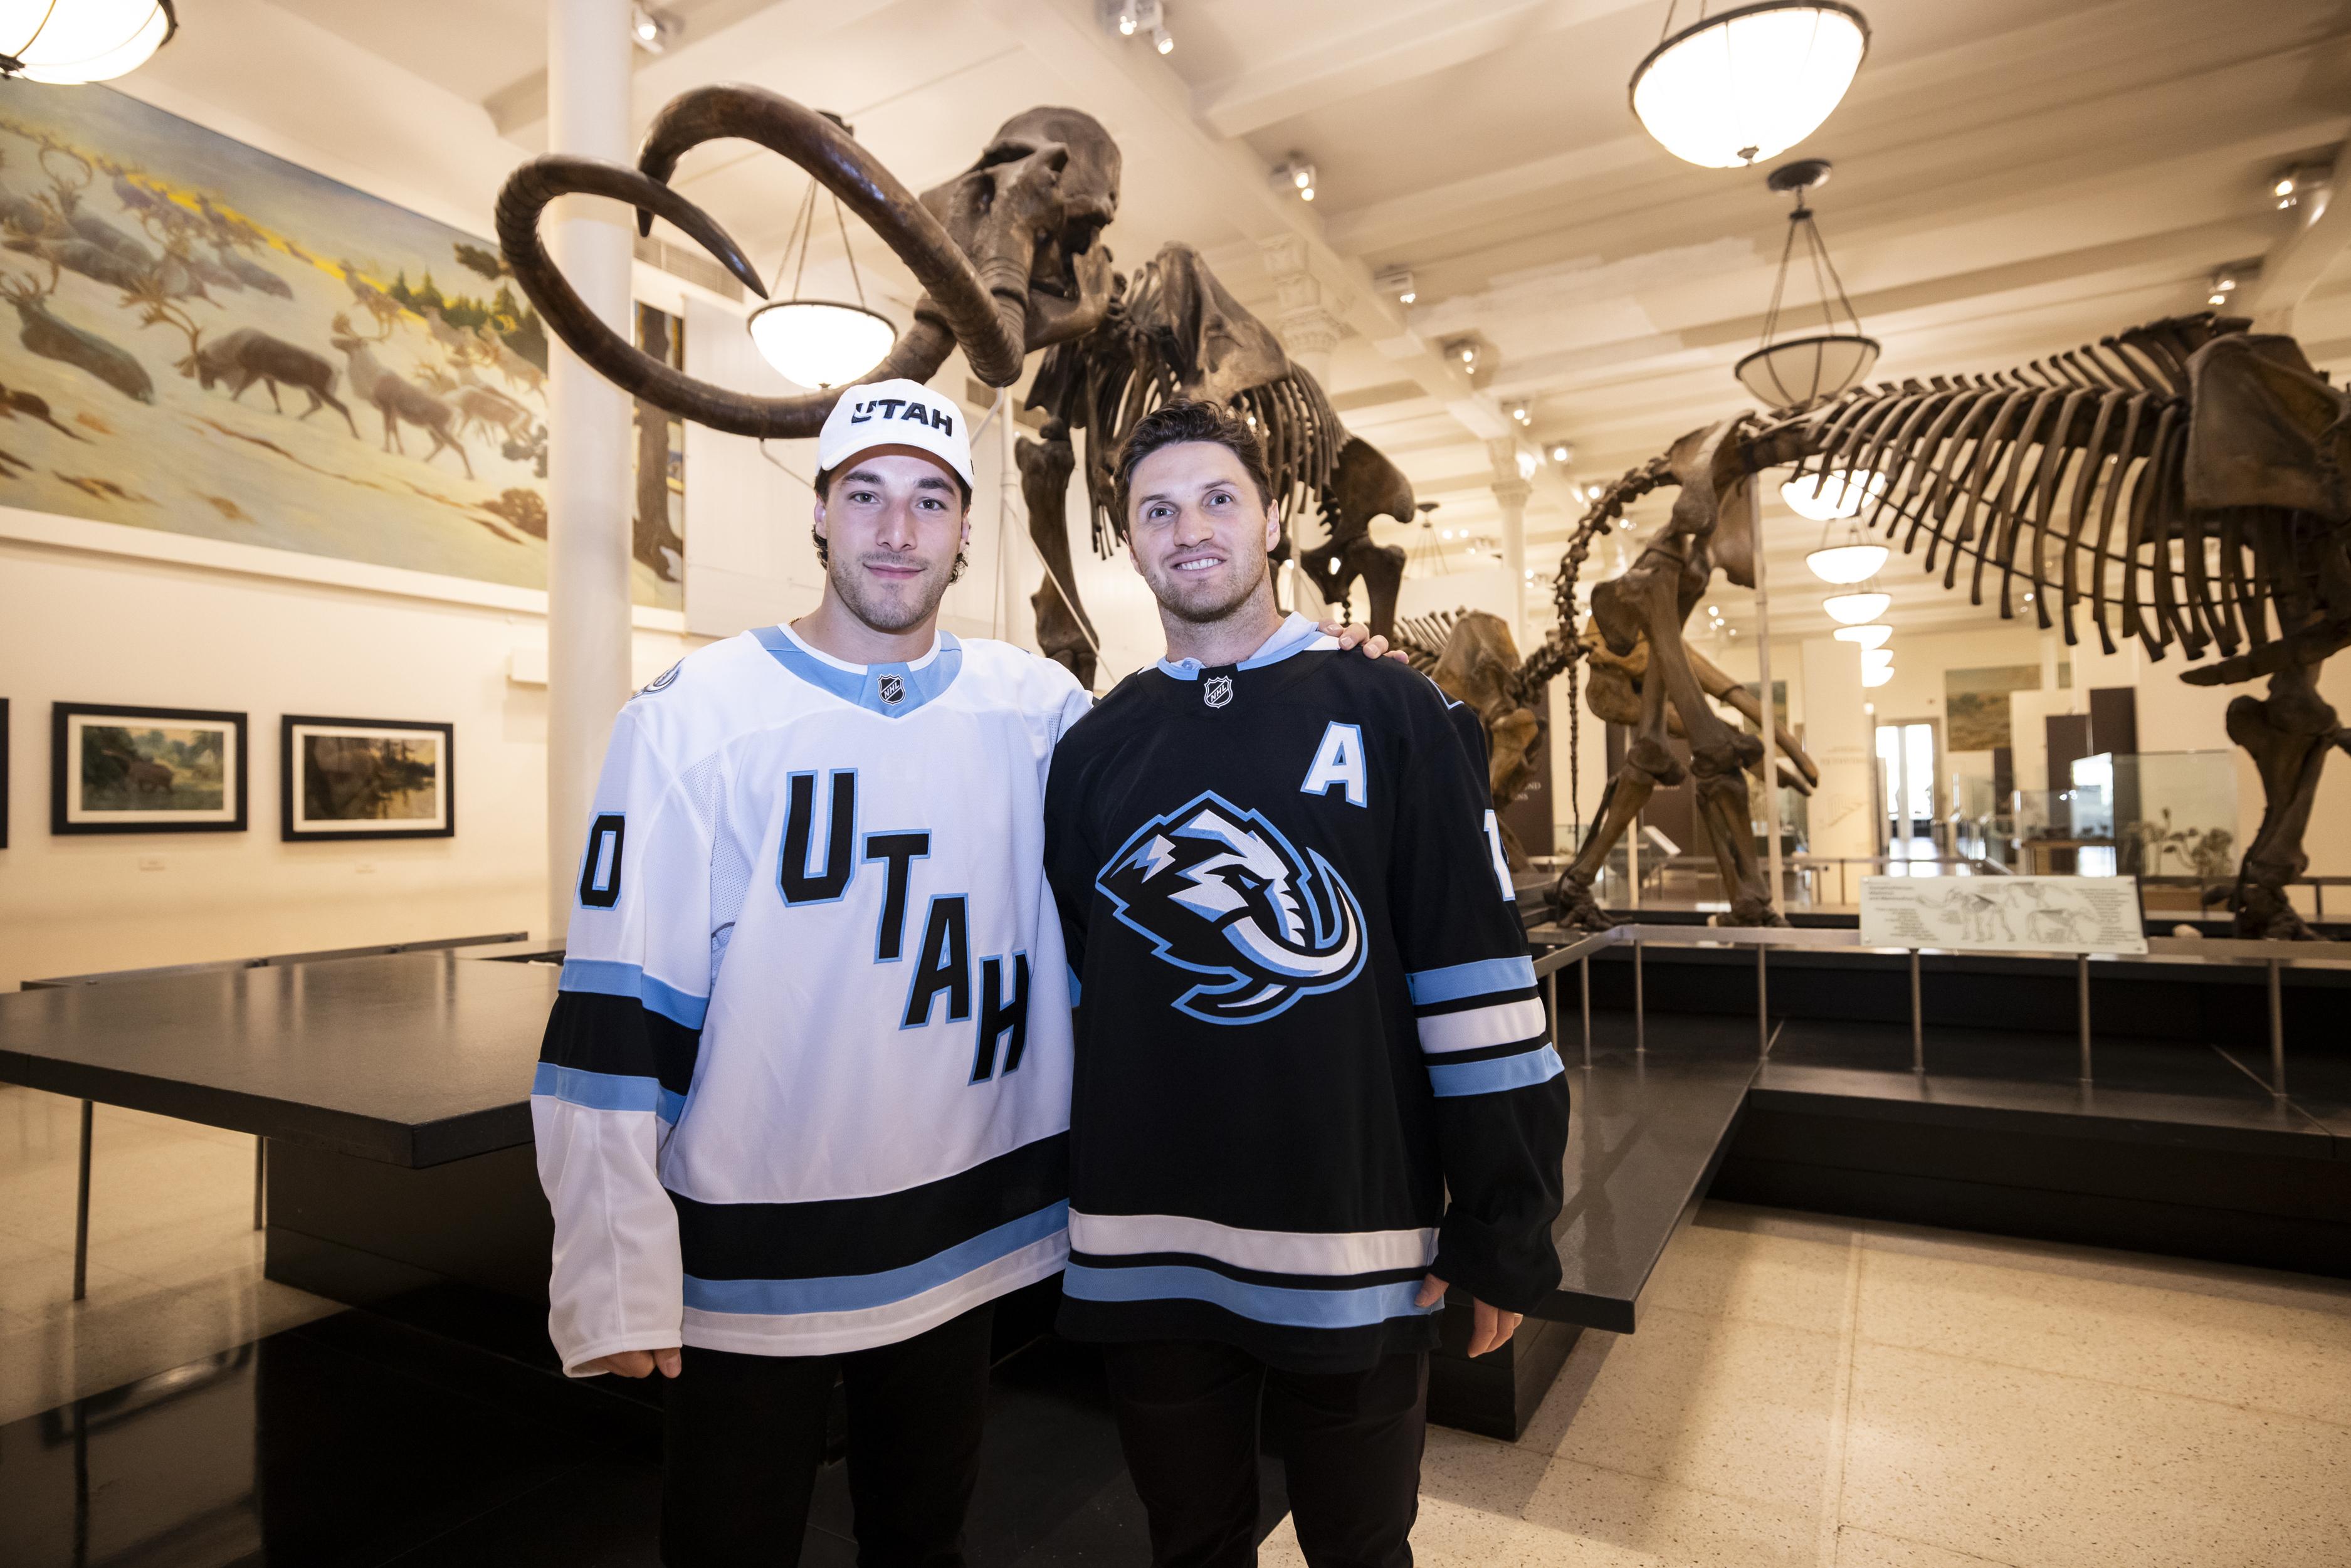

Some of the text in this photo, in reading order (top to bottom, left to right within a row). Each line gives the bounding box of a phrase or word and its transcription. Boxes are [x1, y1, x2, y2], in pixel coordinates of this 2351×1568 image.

[851, 399, 952, 437] UTAH
[884, 682, 900, 698] NHL
[1211, 685, 1227, 702] NHL
[1301, 721, 1368, 808] A
[776, 767, 1029, 1086] UTAH
